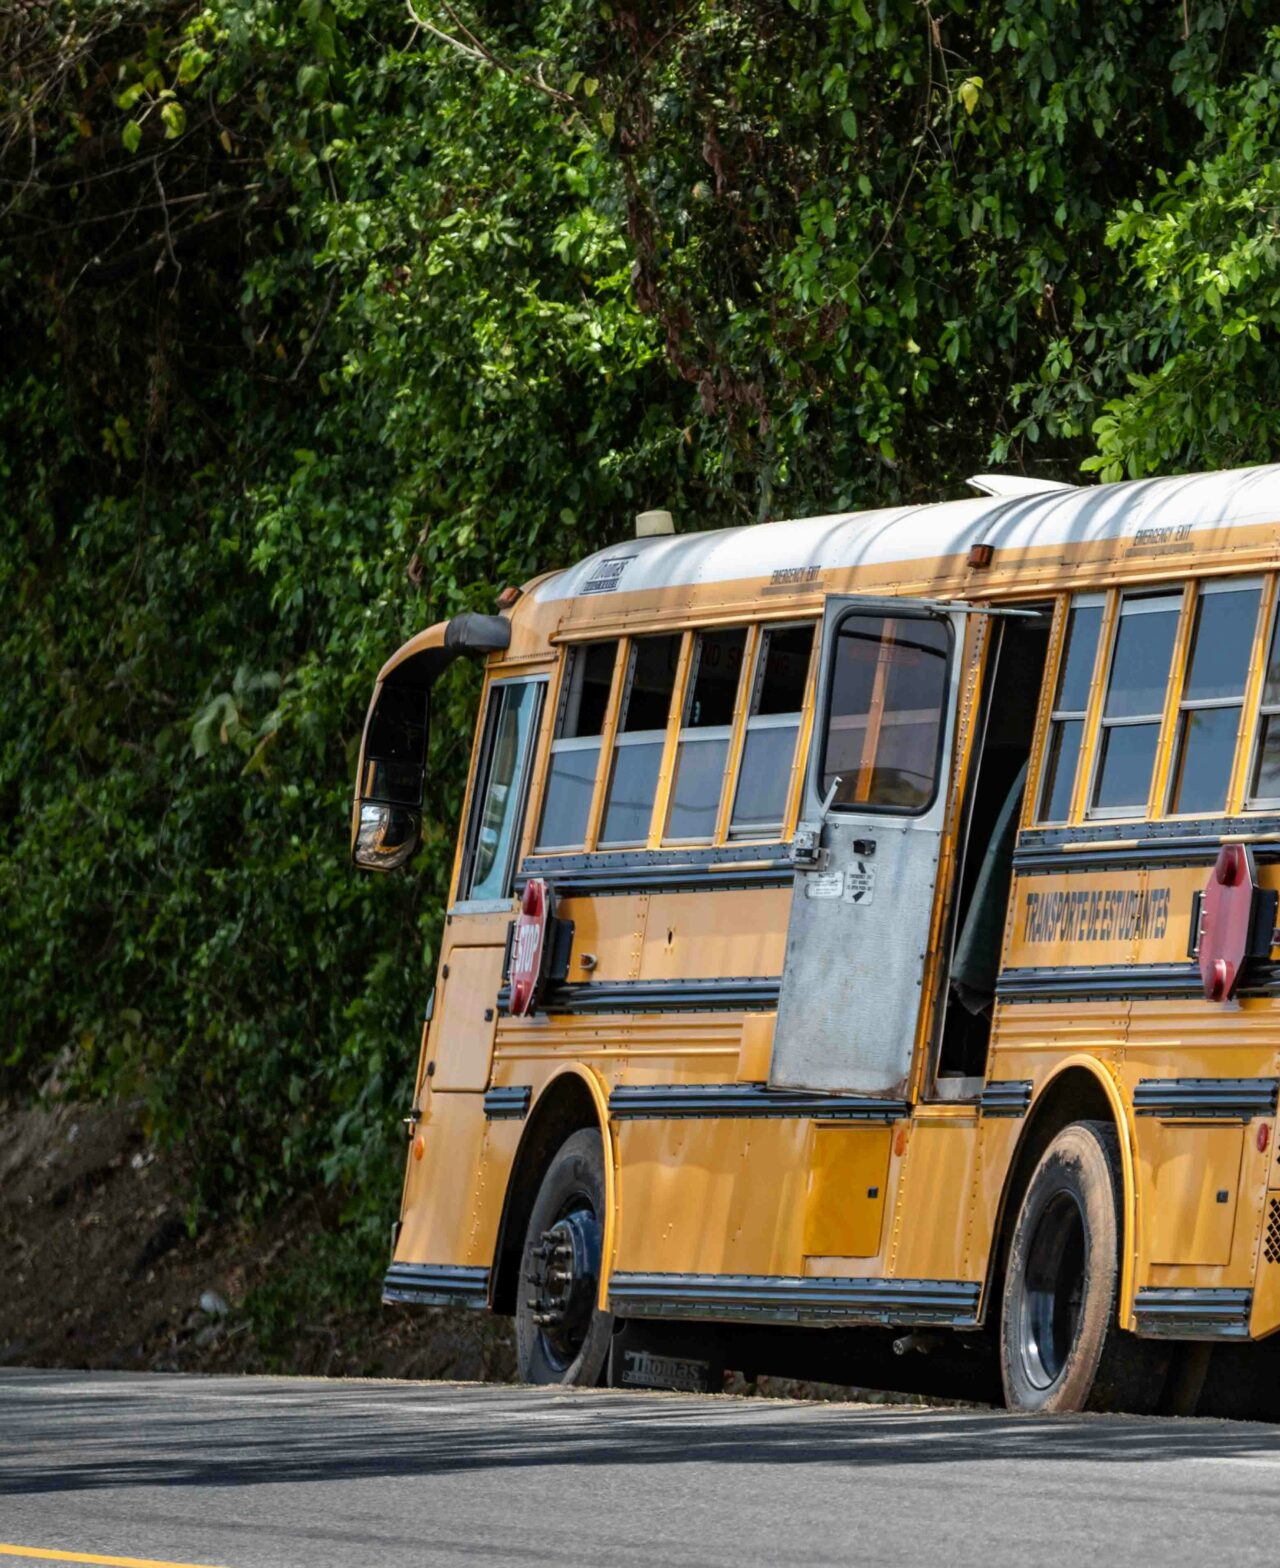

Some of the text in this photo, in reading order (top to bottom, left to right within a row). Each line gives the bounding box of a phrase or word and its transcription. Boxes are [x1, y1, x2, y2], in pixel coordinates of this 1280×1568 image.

[1024, 888, 1170, 942] TRANSPORTE DE ESTUDIANTES
[624, 1350, 710, 1380] Thomas
